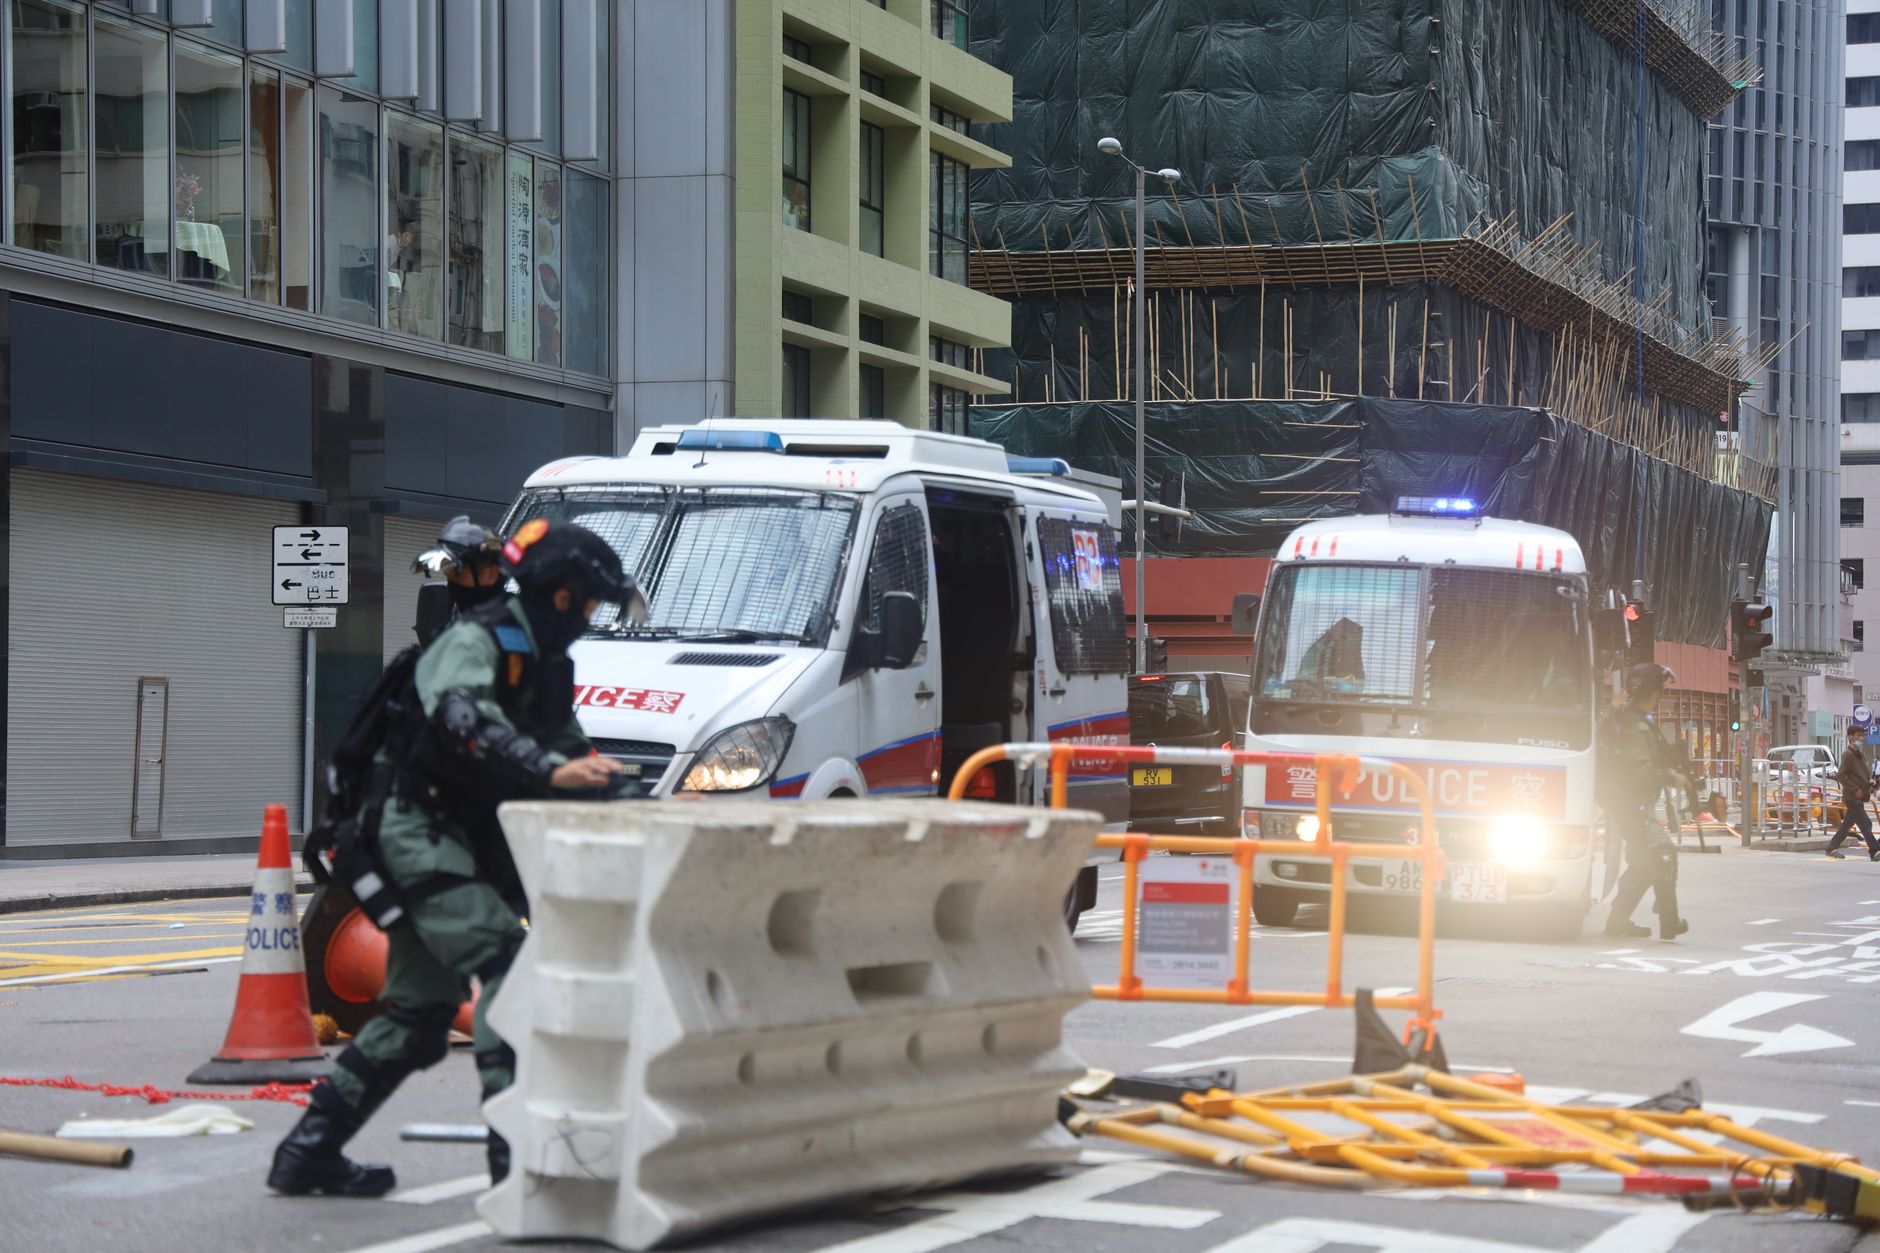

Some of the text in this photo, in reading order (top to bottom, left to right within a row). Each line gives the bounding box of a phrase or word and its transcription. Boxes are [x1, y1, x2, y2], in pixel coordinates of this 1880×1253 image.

[307, 585, 339, 600] 巴士
[640, 690, 681, 713] 察
[1869, 725, 1877, 735] P
[1518, 738, 1569, 749] FUSO
[1145, 768, 1159, 777] RV
[1286, 765, 1318, 799] 警
[1406, 828, 1419, 846] 3
[1386, 874, 1426, 890] 986
[1460, 883, 1498, 901] 3/3
